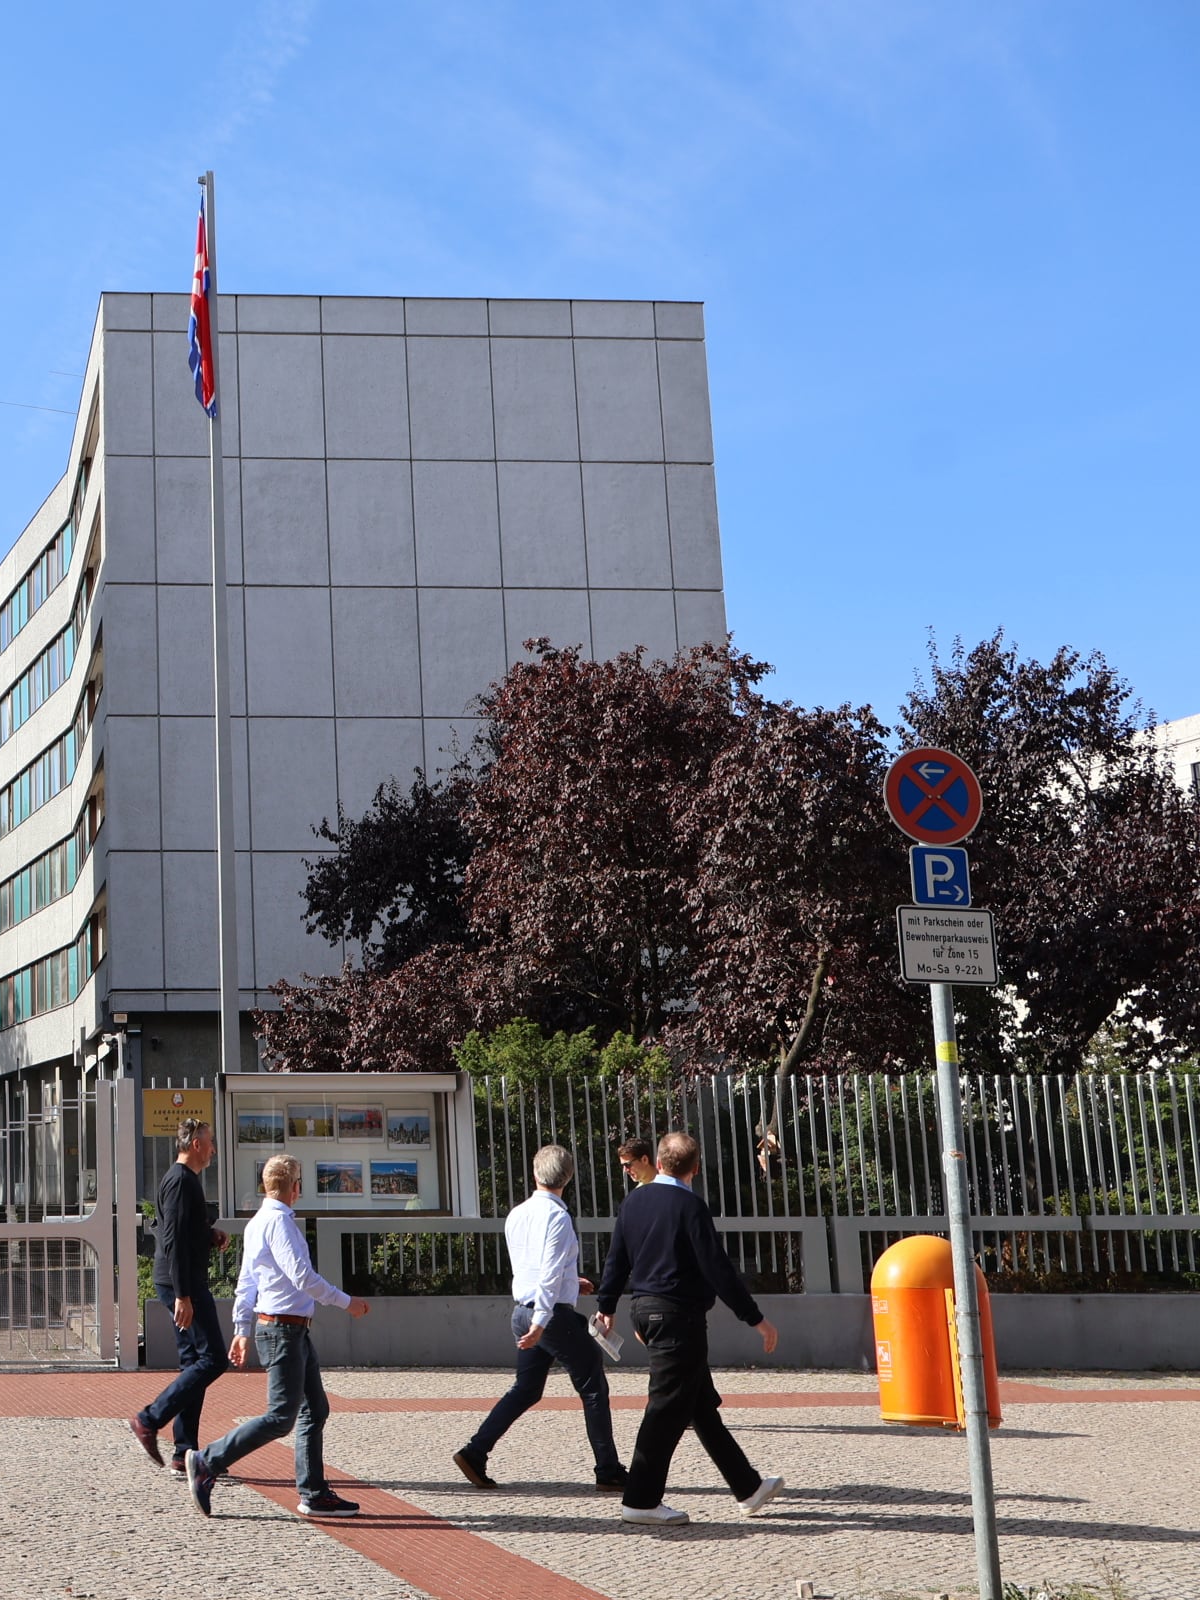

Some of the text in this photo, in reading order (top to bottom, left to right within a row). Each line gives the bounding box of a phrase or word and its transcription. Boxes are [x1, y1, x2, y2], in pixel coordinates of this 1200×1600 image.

[925, 854, 955, 898] P
[907, 916, 984, 928] mit Parkschein oder
[906, 931, 989, 944] Bewohnerparkausweis
[932, 948, 979, 959] für Zone 15
[917, 963, 983, 975] Mo-Sa 9-22h
